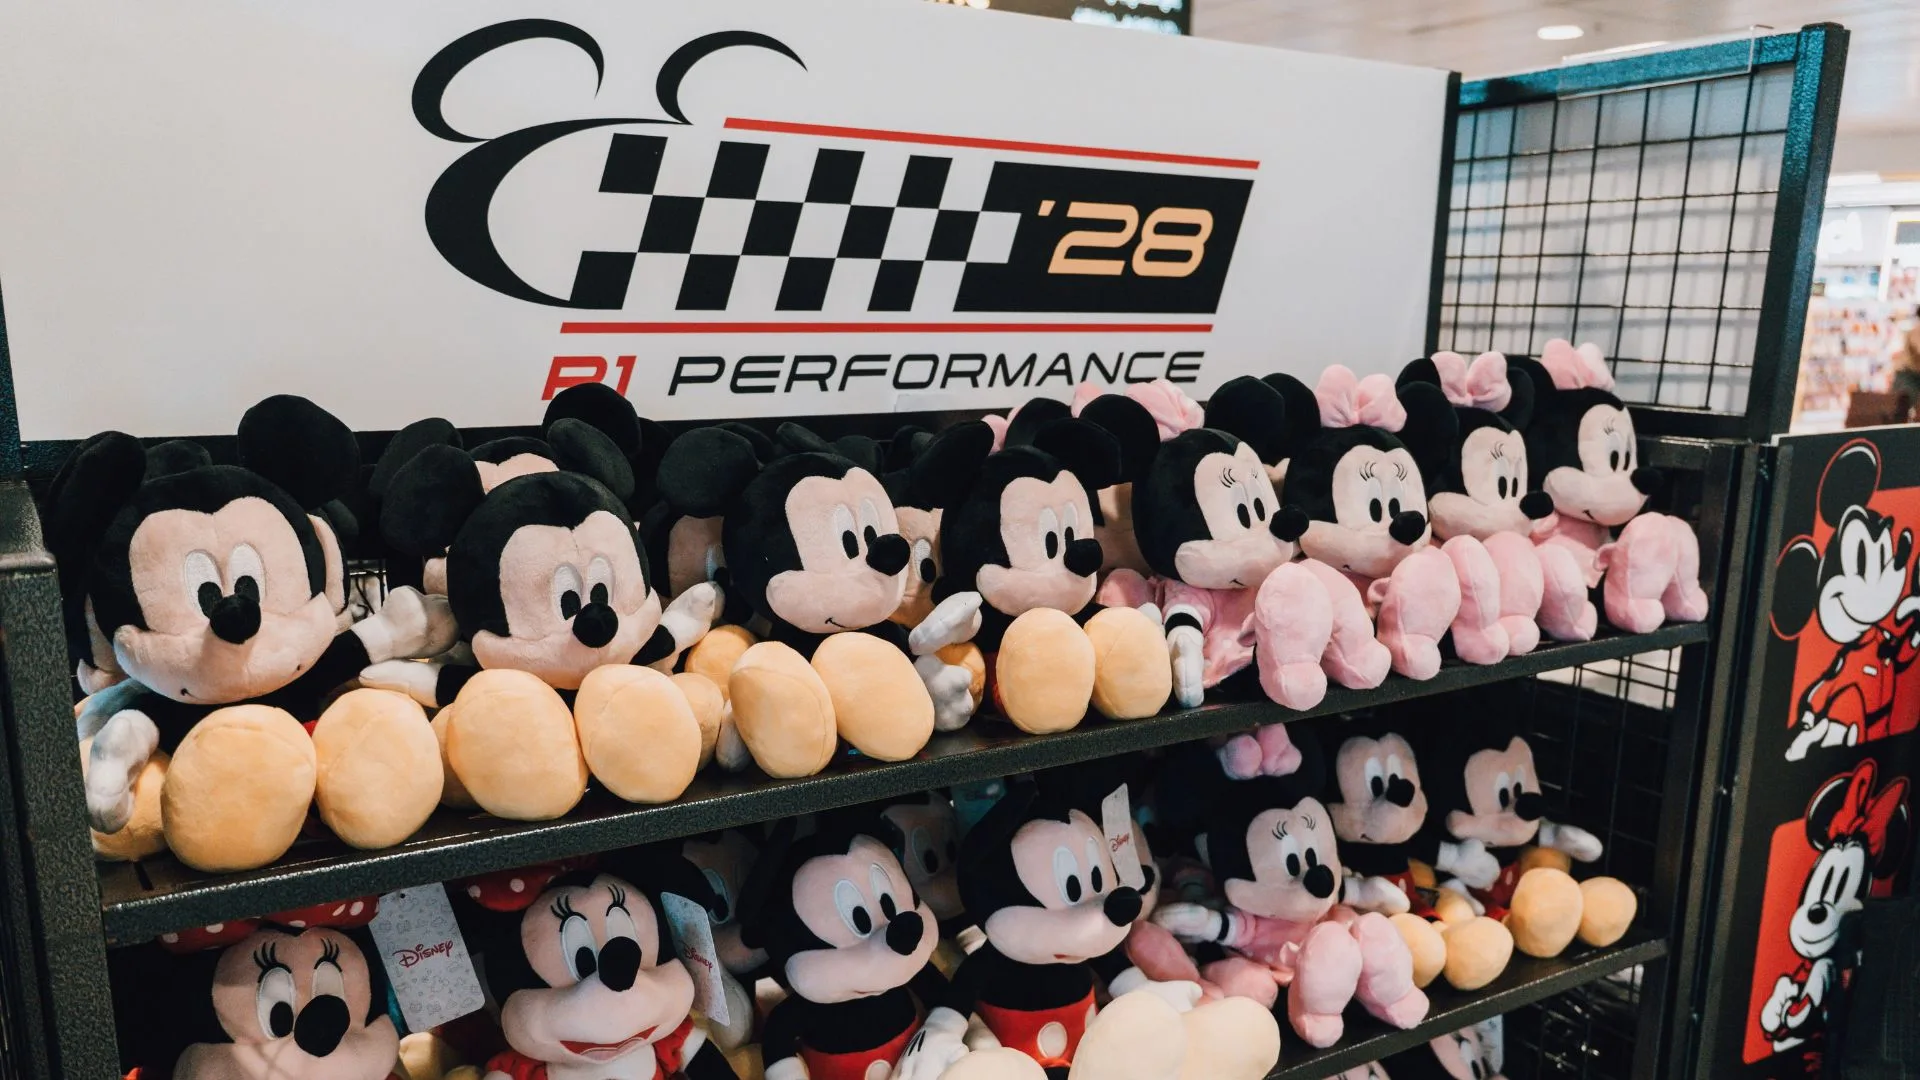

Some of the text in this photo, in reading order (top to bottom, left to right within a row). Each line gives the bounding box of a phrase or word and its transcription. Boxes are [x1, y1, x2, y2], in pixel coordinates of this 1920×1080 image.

[1038, 199, 1214, 278] '28
[668, 350, 1204, 397] PERFORMANCE
[392, 940, 454, 968] Disney
